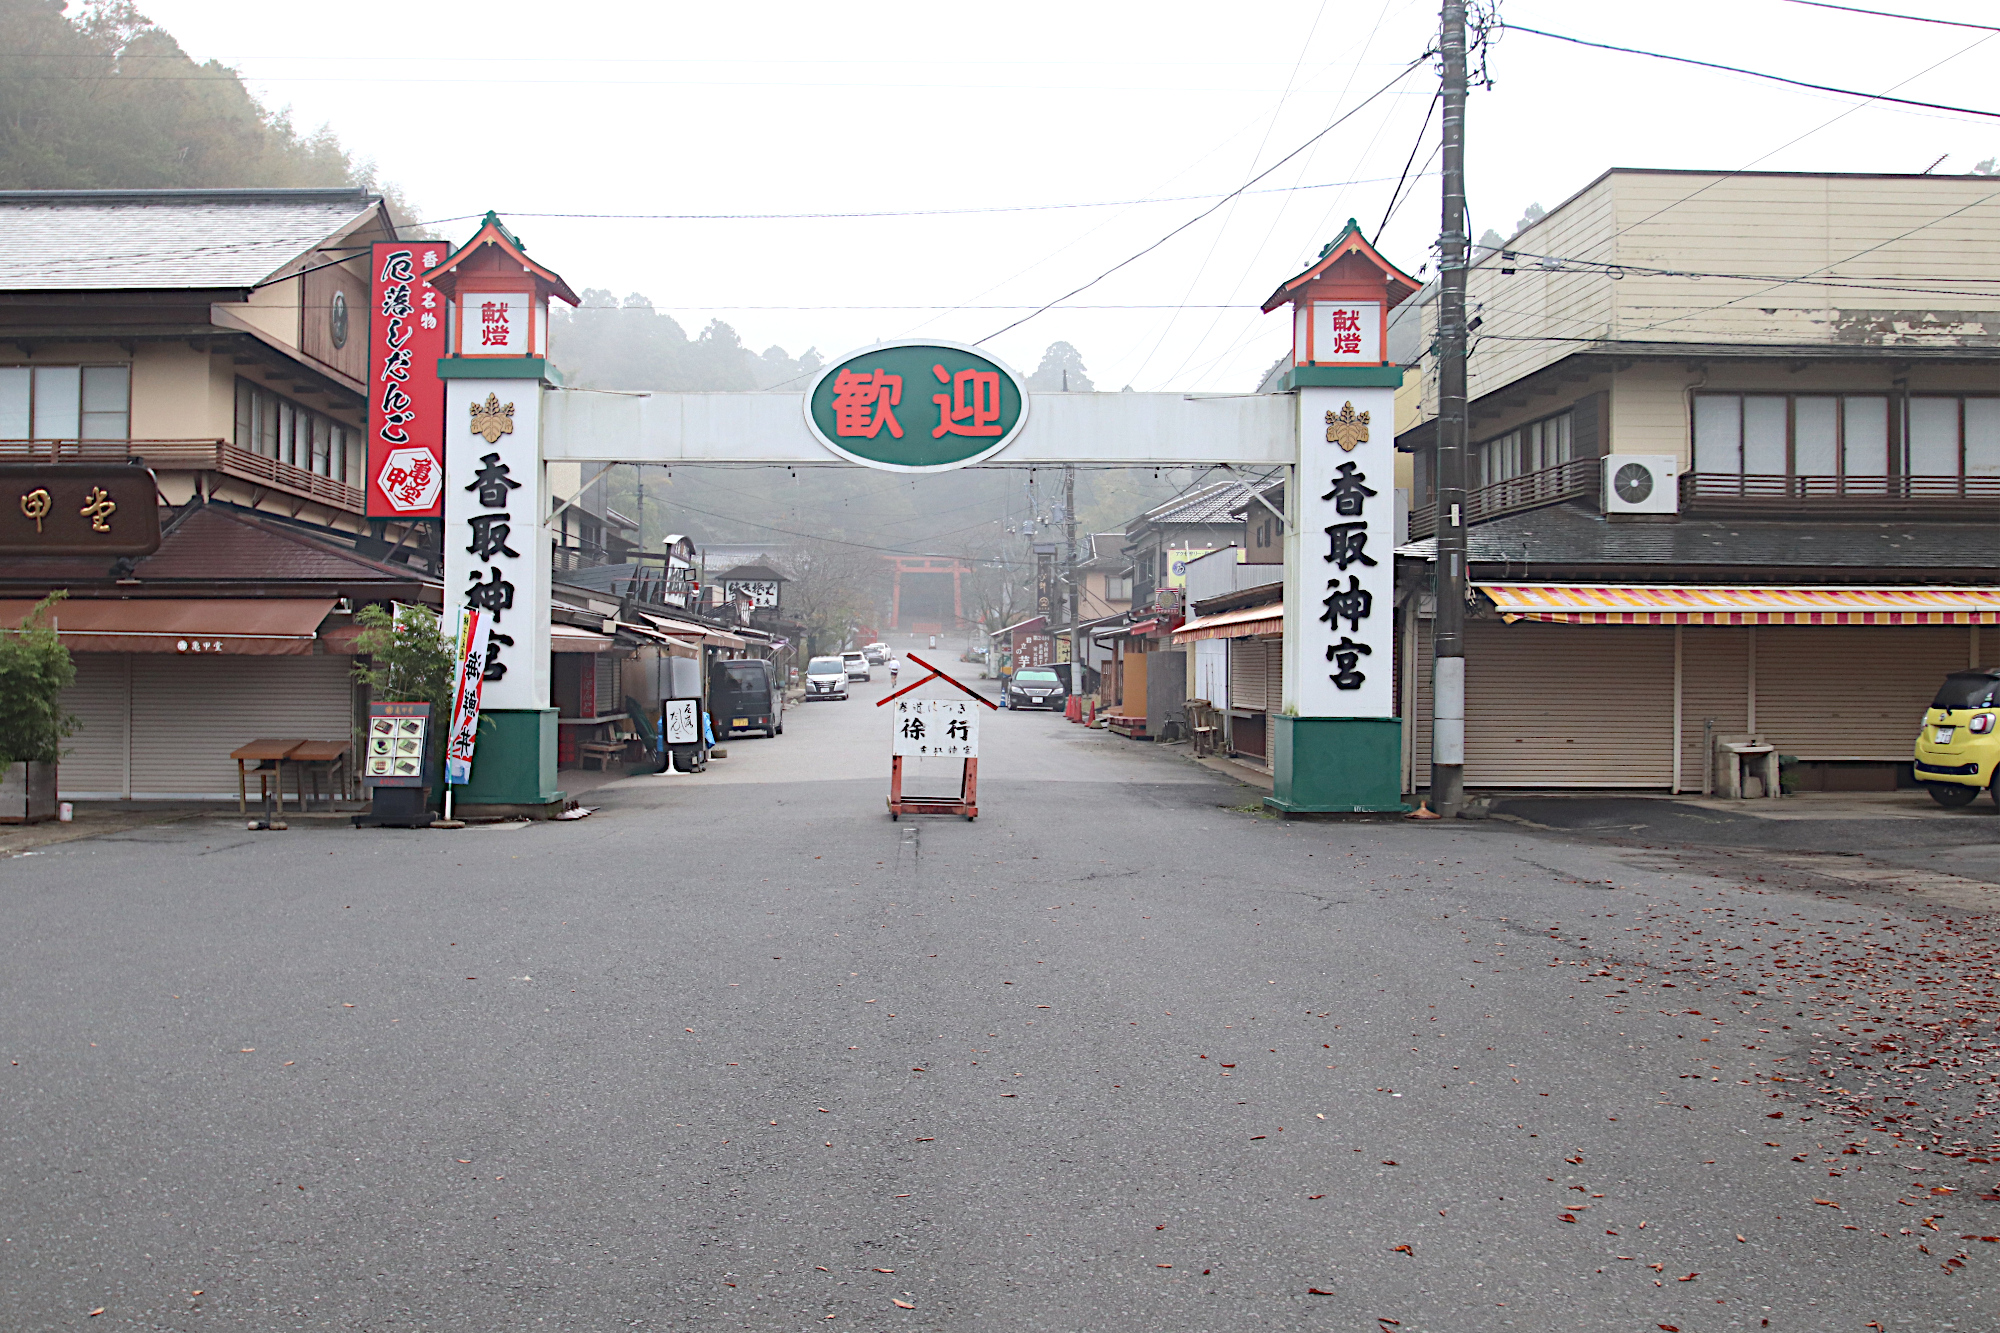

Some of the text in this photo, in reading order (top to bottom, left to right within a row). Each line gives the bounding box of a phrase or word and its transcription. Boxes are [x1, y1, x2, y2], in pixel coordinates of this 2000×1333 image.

[421, 250, 438, 329] 香名物
[481, 301, 509, 347] 献燈
[380, 250, 416, 444] 厄落しだんご
[1333, 309, 1361, 354] 献燈
[832, 364, 1003, 439] 歓迎
[1319, 461, 1378, 690] 香取神宮
[900, 717, 973, 741] 徐行
